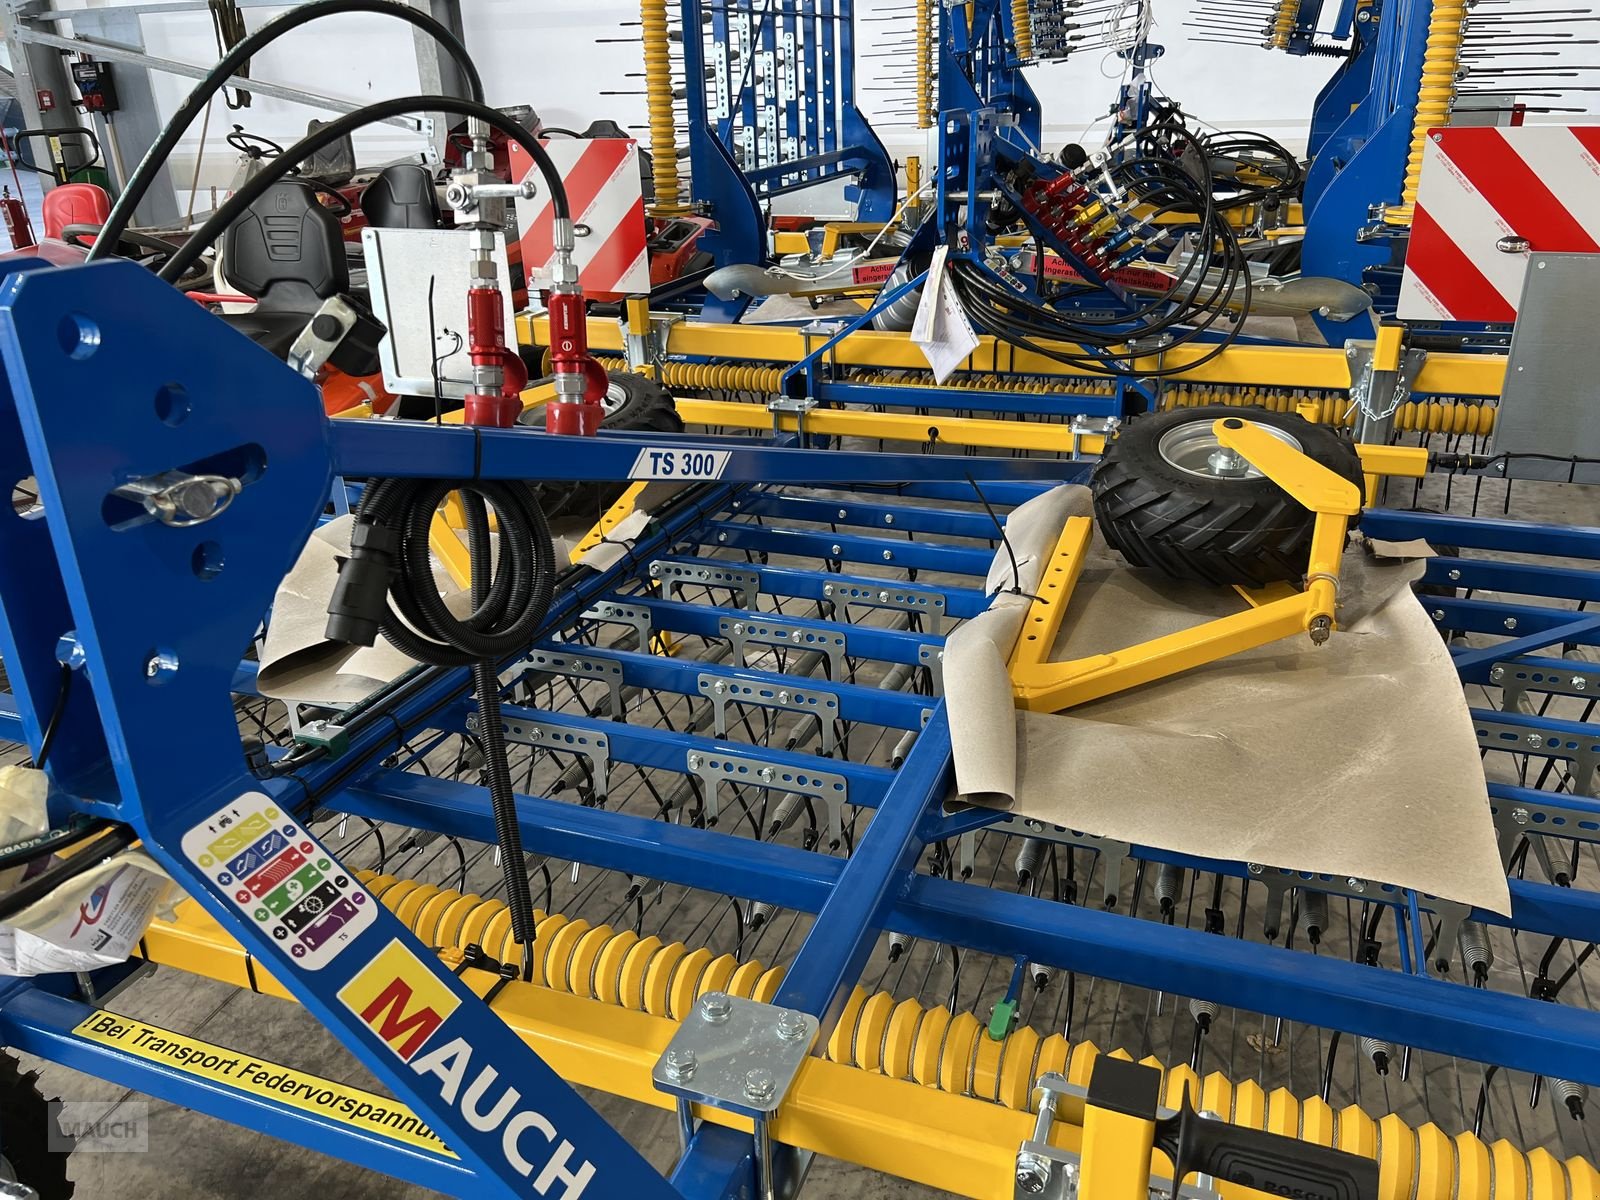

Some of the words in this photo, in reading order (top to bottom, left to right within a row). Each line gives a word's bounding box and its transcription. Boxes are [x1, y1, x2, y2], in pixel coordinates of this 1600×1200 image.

[649, 452, 675, 476] TS
[681, 453, 715, 476] 300
[338, 932, 349, 941] TS
[132, 1028, 240, 1075] Transport
[236, 1062, 453, 1152] Federvorspannu
[360, 976, 597, 1200] MAUCH
